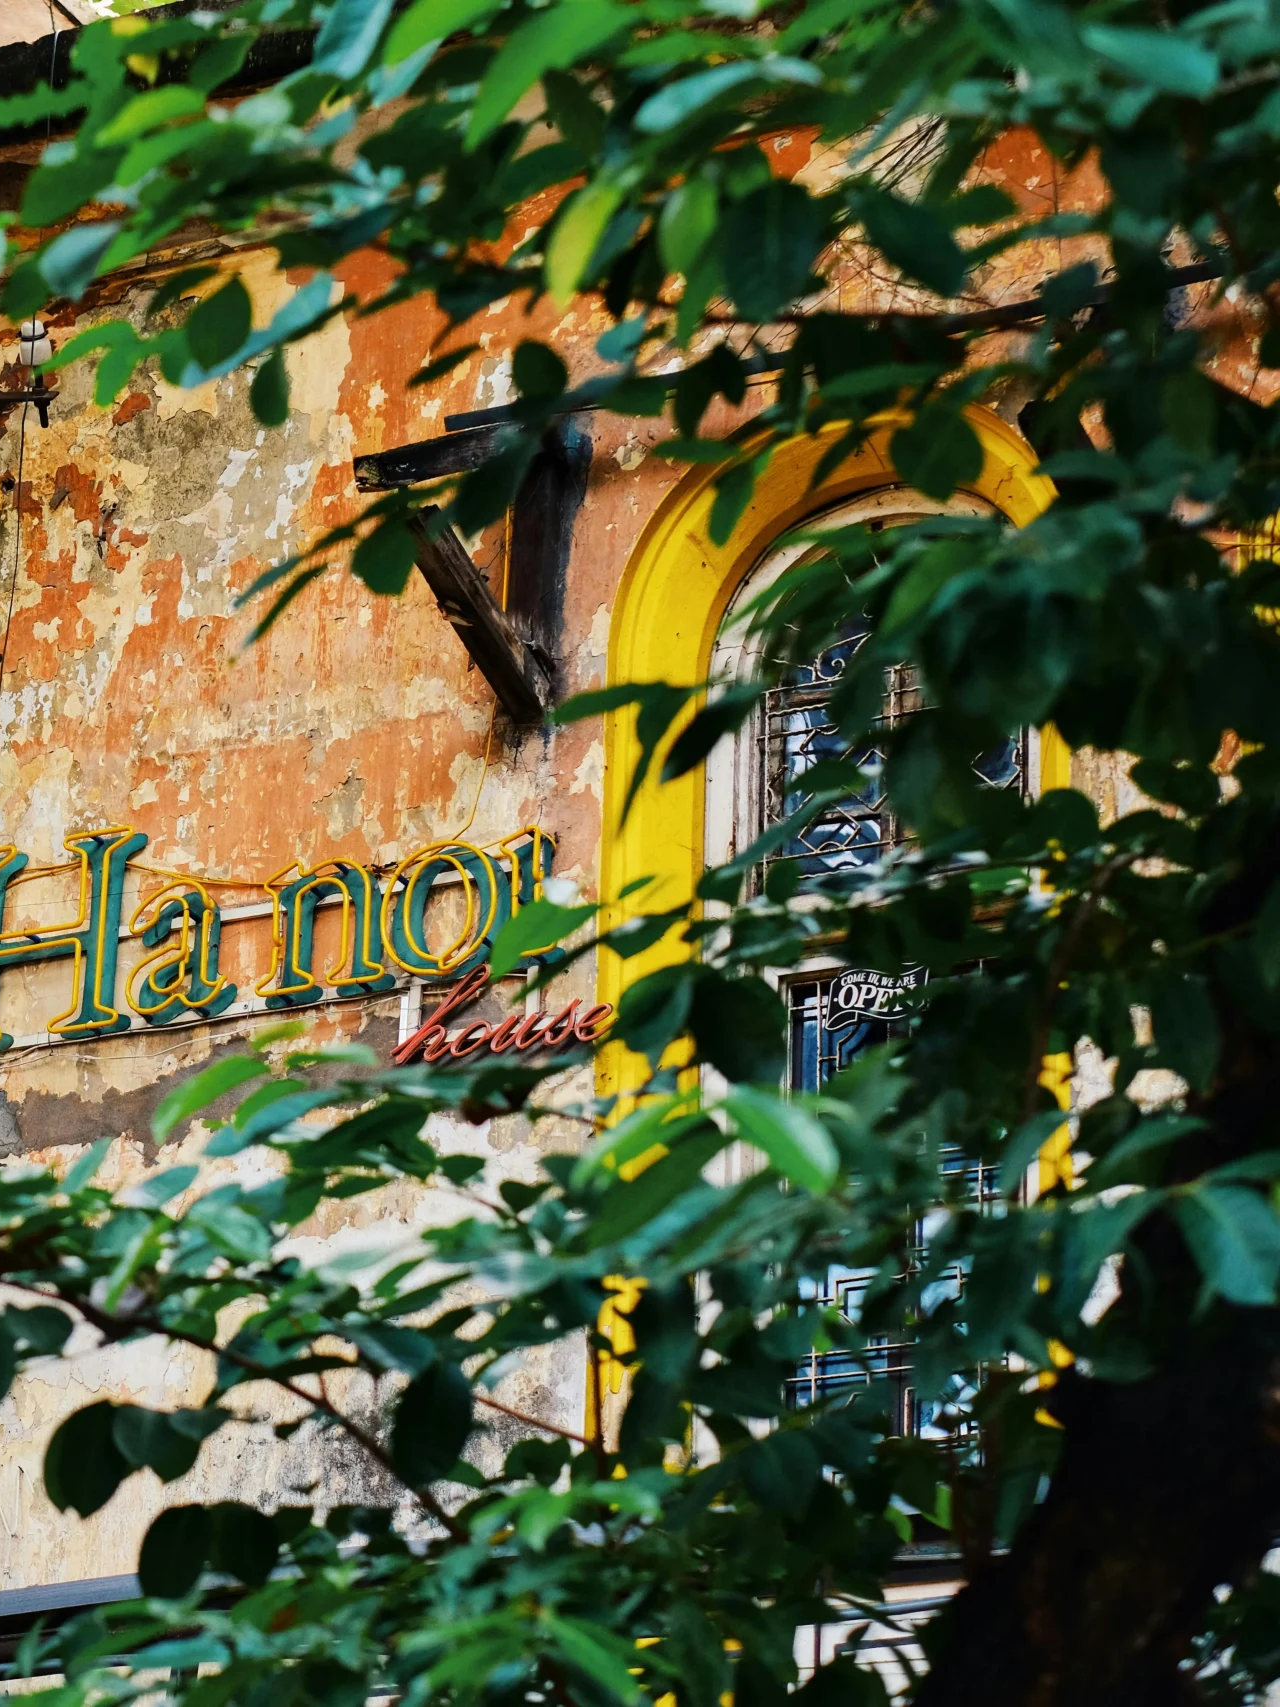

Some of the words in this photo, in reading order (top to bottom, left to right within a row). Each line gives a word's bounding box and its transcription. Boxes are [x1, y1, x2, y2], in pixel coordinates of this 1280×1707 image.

[840, 972, 866, 987] COME
[881, 976, 895, 987] WE
[896, 974, 916, 987] ARE
[391, 962, 619, 1064] house
